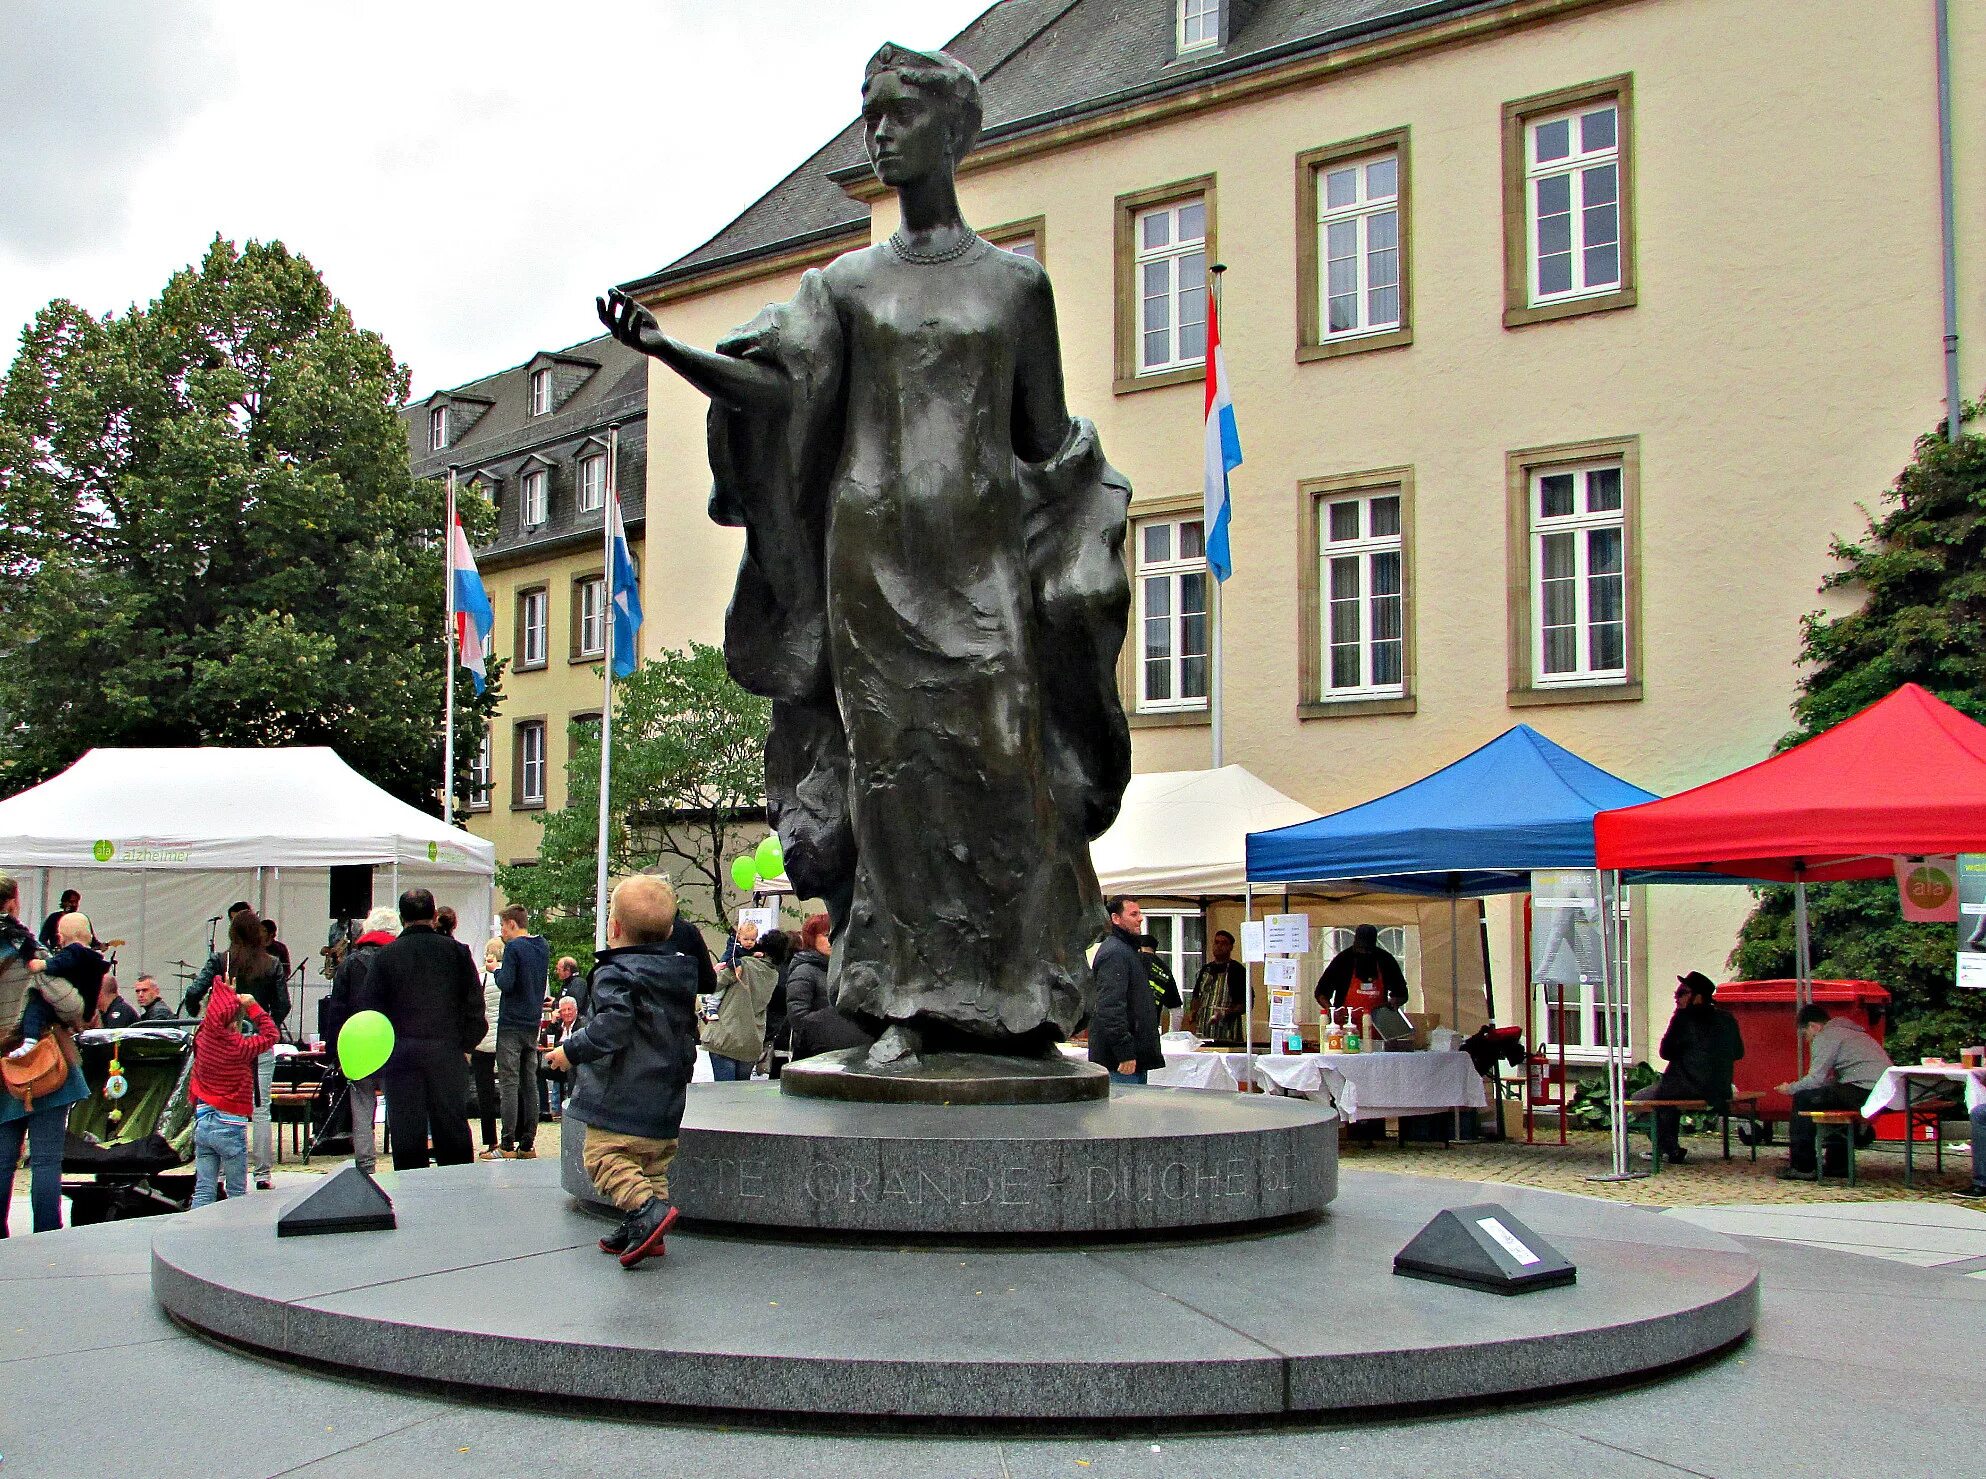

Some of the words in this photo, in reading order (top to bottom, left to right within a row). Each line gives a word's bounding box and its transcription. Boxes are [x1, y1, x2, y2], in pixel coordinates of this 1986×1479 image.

[122, 848, 191, 862] alzheimer
[805, 1163, 1031, 1204] GRANDE
[1086, 1154, 1299, 1204] DUCHESE
